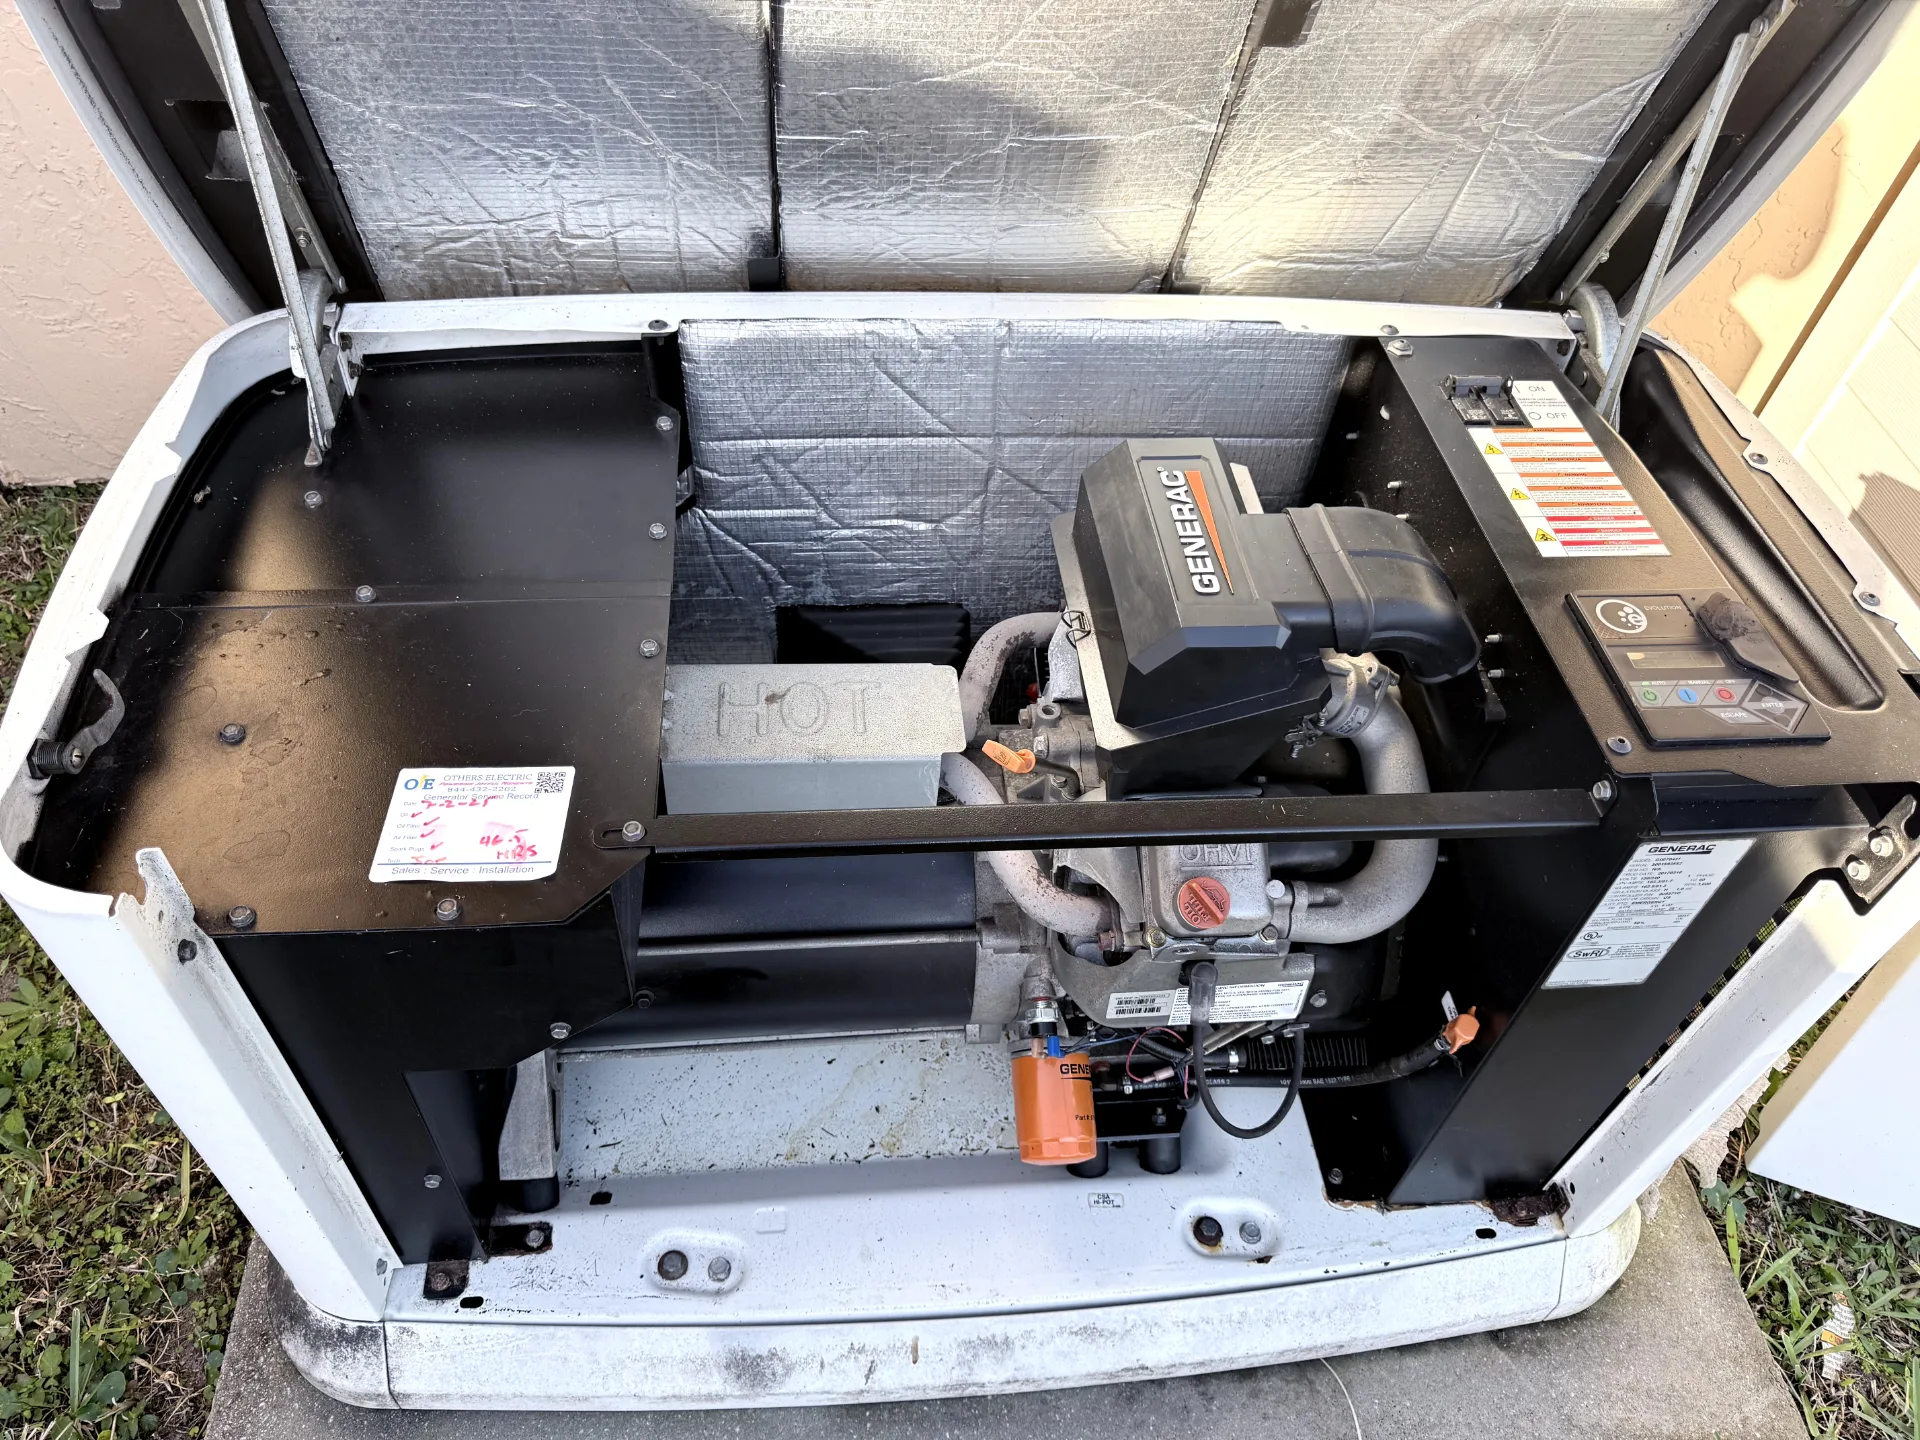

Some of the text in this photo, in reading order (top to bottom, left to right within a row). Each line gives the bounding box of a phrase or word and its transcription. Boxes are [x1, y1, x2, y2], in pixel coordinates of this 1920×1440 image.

[1159, 468, 1221, 596] GENERAC
[717, 680, 882, 739] HOT
[1719, 711, 1748, 719] ESCAPE
[423, 793, 469, 801] Generator
[1647, 844, 1717, 854] GENERAC
[391, 866, 421, 875] Sales
[430, 866, 469, 875] Service
[479, 865, 535, 874] Installation
[1573, 949, 1605, 958] SwRI
